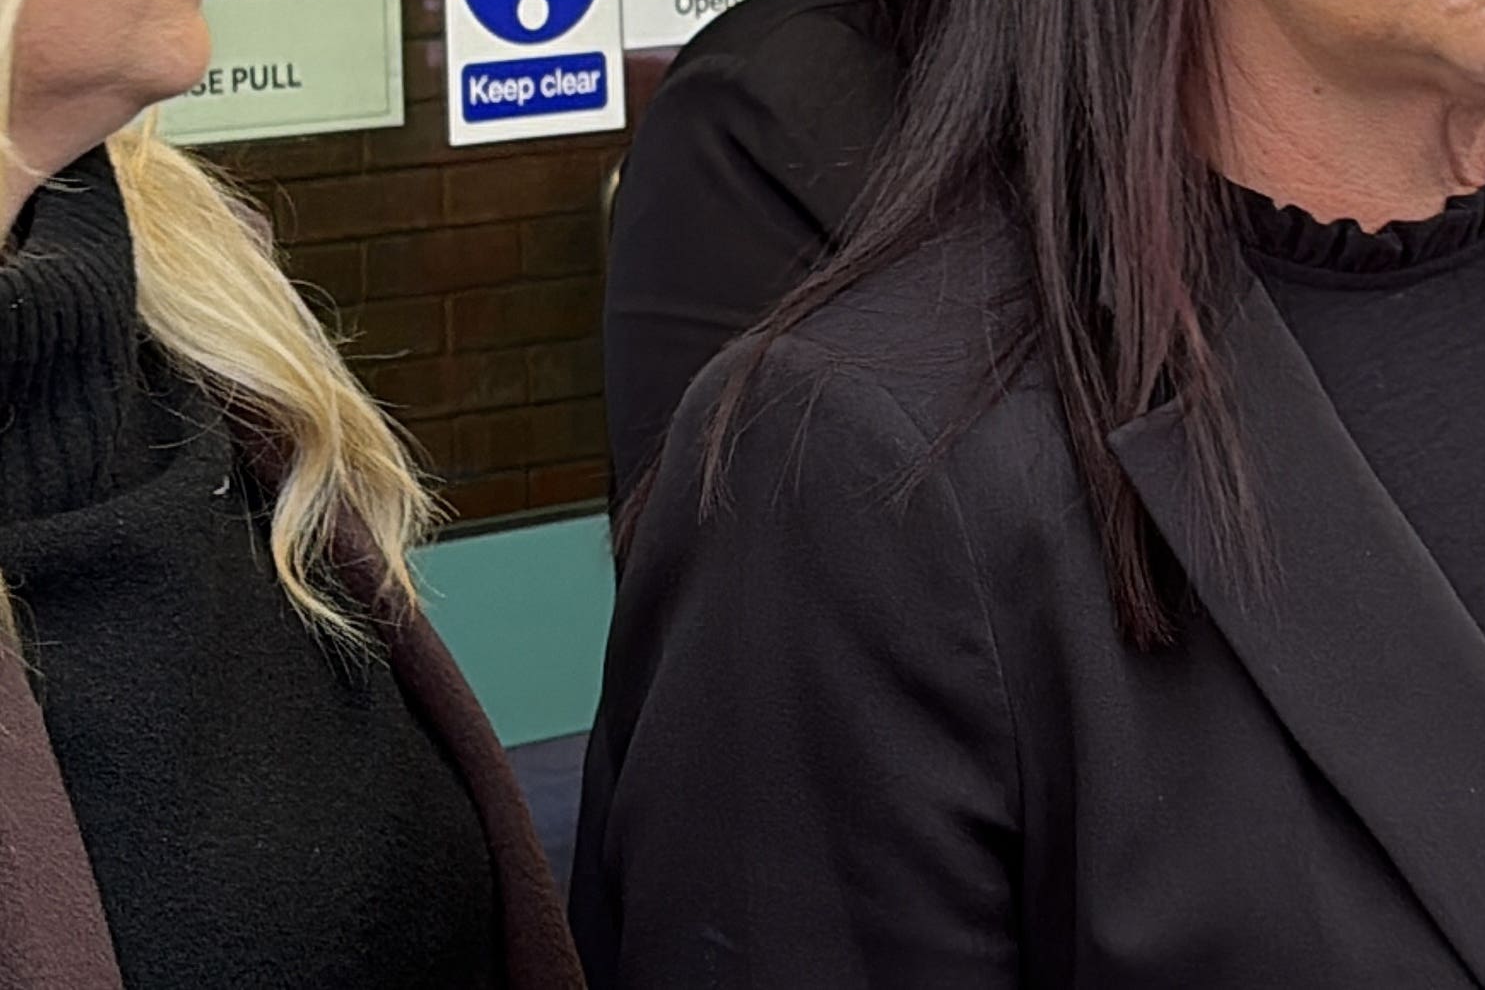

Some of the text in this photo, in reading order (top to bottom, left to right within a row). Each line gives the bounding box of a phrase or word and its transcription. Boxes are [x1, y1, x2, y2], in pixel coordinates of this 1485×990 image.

[231, 62, 302, 93] PULL
[469, 67, 601, 106] Keep clear
